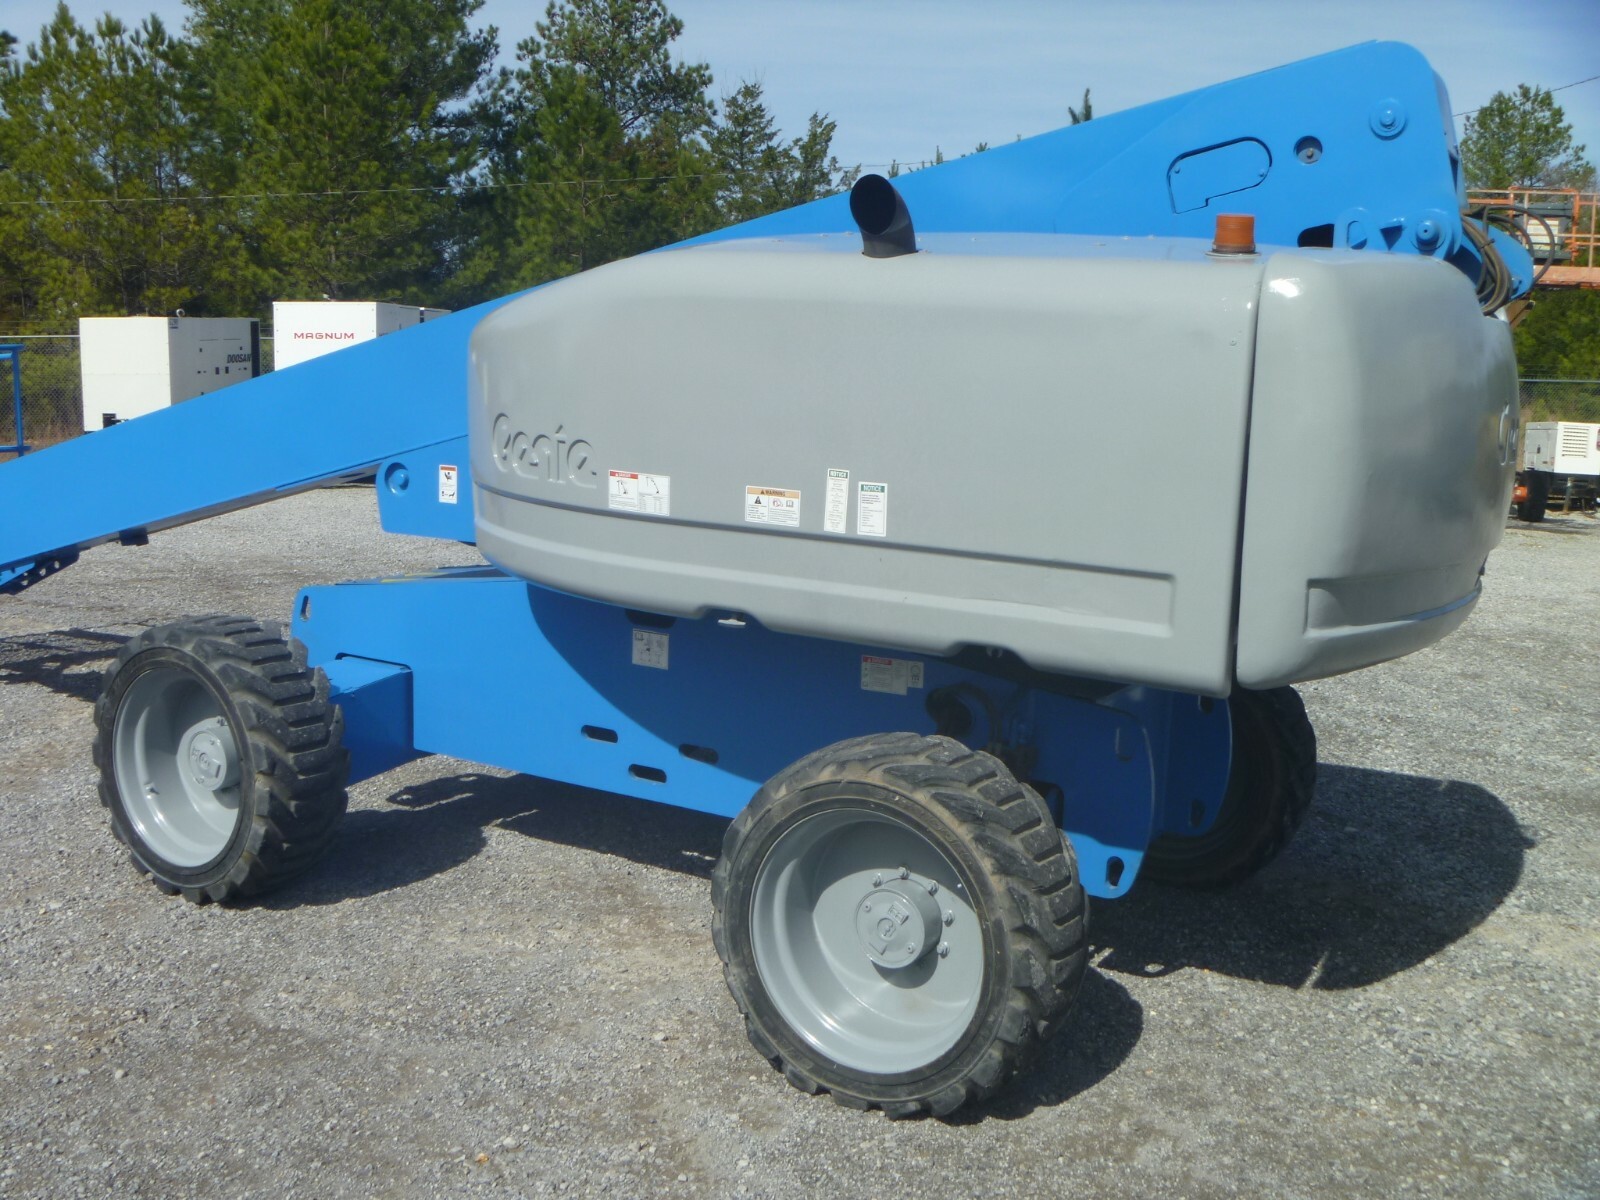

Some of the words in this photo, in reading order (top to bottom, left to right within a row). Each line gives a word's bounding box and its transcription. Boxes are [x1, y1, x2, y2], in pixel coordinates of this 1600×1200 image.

[293, 332, 355, 340] MAGNUM
[227, 354, 252, 363] DOOSAN
[492, 412, 597, 489] Genie
[863, 484, 881, 492] NOTICE
[765, 489, 786, 497] WARNING
